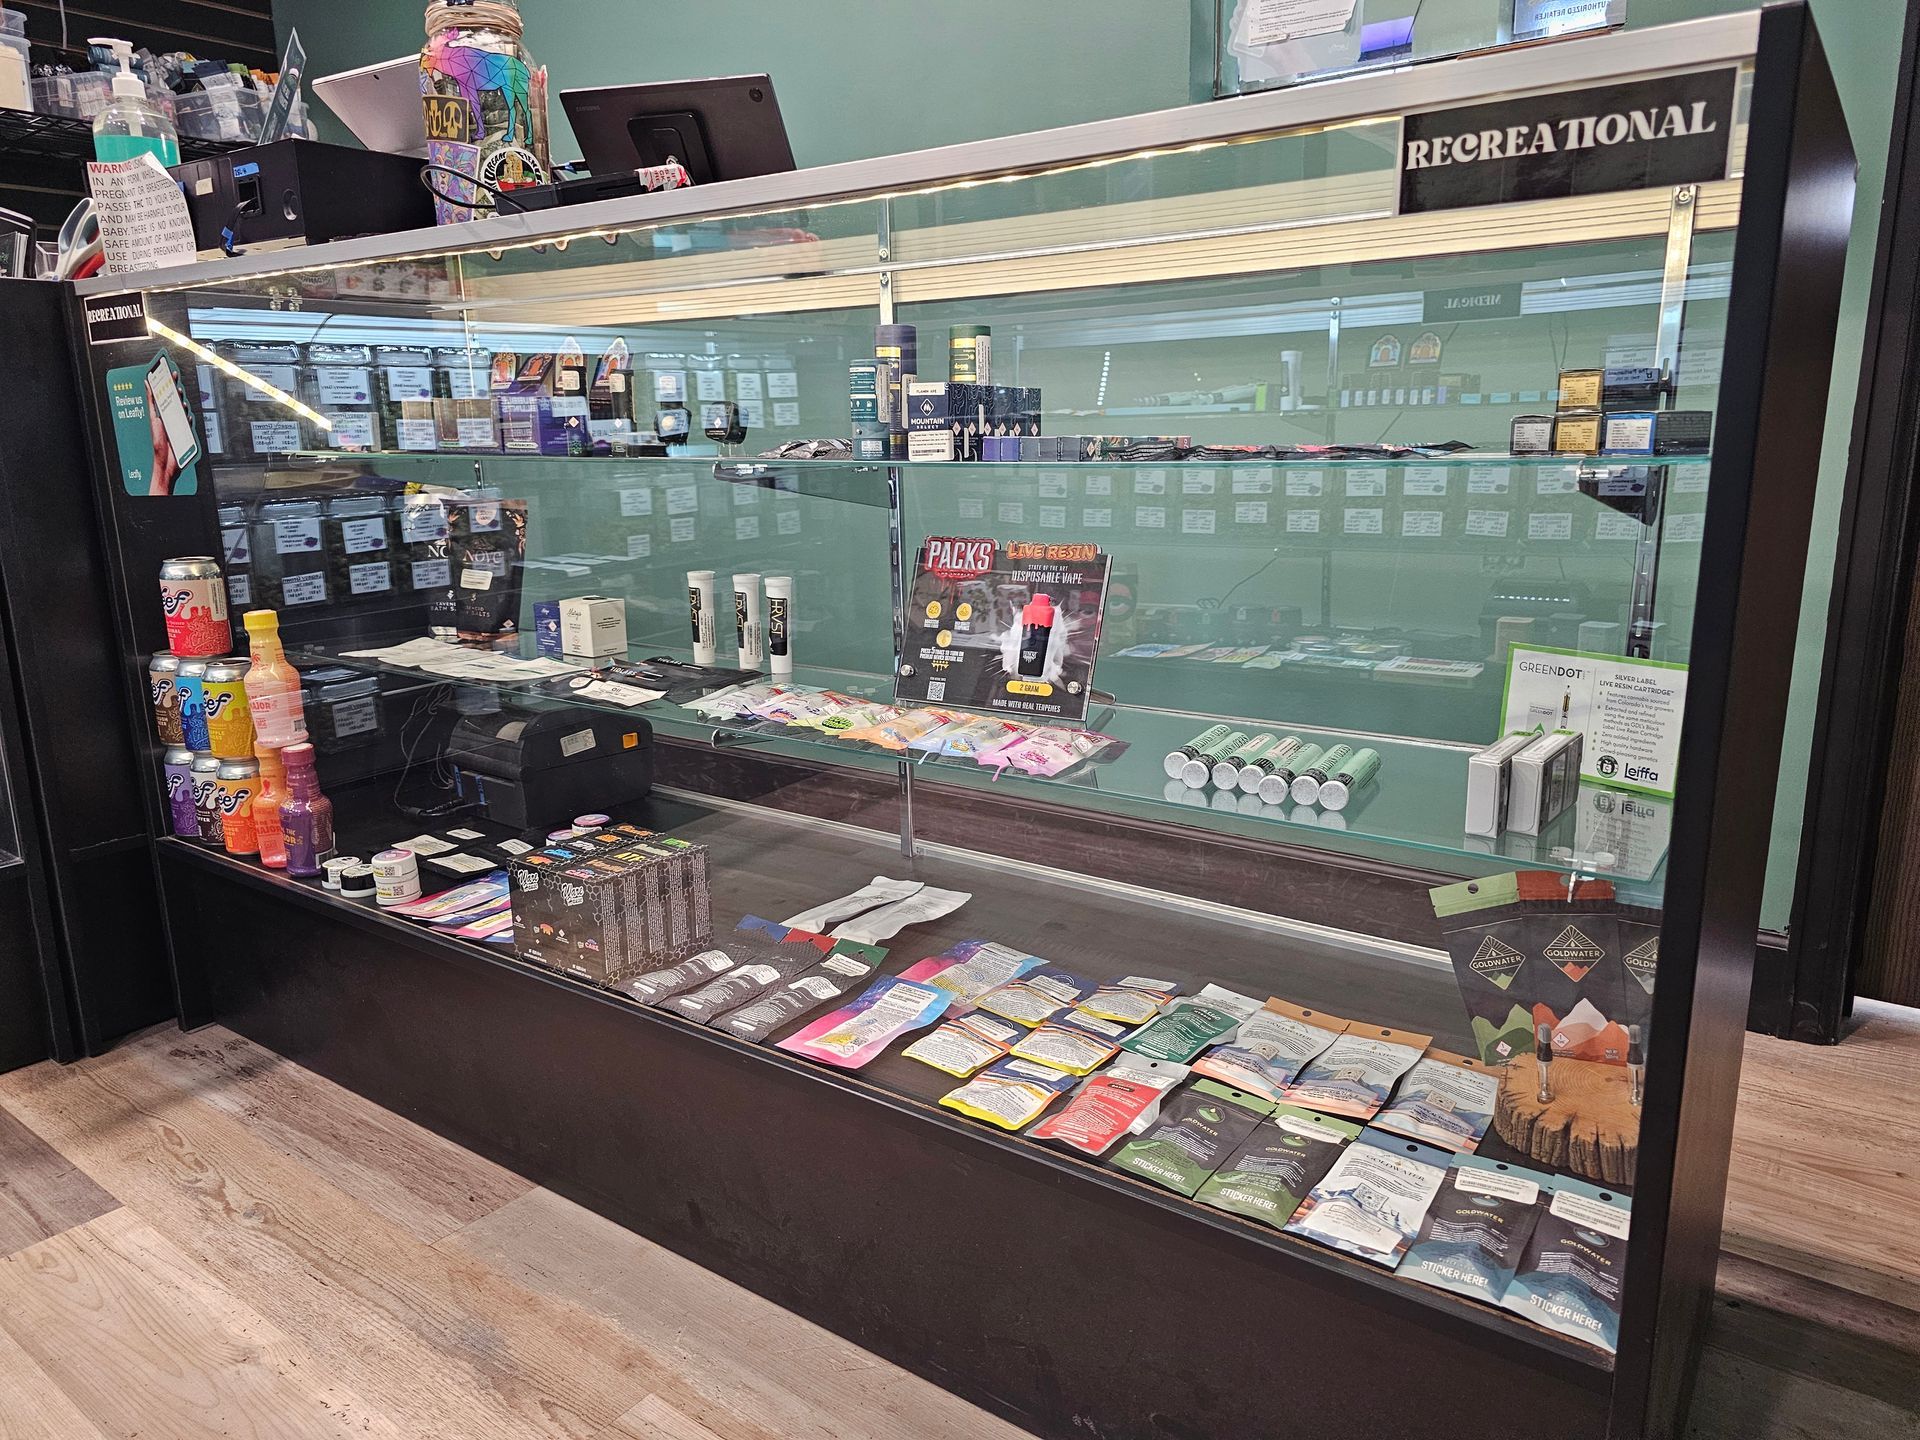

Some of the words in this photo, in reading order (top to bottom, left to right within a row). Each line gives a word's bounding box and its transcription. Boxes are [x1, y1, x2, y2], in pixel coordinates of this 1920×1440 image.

[1405, 101, 1717, 170] RECREATIONAL
[90, 161, 132, 174] WARNING
[92, 177, 104, 186] IN
[110, 177, 126, 186] ANY
[95, 188, 136, 199] PREGNANT
[98, 202, 132, 212] PASSES
[146, 196, 152, 206] TO
[155, 194, 168, 204] YOUR
[100, 215, 122, 224] AND
[144, 209, 166, 220] HARMFUL
[102, 228, 130, 236] BABY.
[158, 220, 166, 230] NO
[169, 216, 190, 228] KNOWN
[105, 240, 130, 248] SAFE
[132, 236, 152, 248] AMOUNT
[164, 229, 192, 242] MARIJUANA
[107, 252, 128, 260] USE
[154, 244, 184, 256] PREGNANCY
[186, 242, 195, 251] OR
[88, 304, 143, 323] RECREATIONAL
[116, 396, 133, 406] Review
[134, 396, 142, 404] us
[118, 411, 125, 420] on
[927, 540, 992, 570] PACKS
[1007, 541, 1044, 560] LIVE
[1046, 544, 1096, 560] RESIN
[1012, 570, 1060, 584] DISPOSABLE
[1062, 572, 1083, 584] VAPE
[771, 598, 784, 638] HRVST
[1519, 662, 1582, 678] GREENDOT
[1020, 684, 1024, 692] 2
[1024, 684, 1040, 692] GRAM
[1614, 682, 1632, 690] RESIN
[1615, 674, 1636, 682] SILVER
[1636, 677, 1656, 686] LABEL
[992, 699, 1007, 708] MADE
[1036, 702, 1061, 714] TERPENES
[1472, 955, 1522, 968] GOLDWATER
[1546, 949, 1600, 958] GOLDWATER
[1626, 956, 1657, 968] GOLDW
[1265, 1146, 1306, 1158] GOLDWATER
[1132, 1157, 1164, 1176] STICKER
[1162, 1170, 1186, 1184] HERE!
[1220, 1188, 1254, 1204] STICKER
[1252, 1197, 1277, 1212] HERE!
[1456, 1208, 1504, 1224] GOLDWATER
[1560, 1238, 1612, 1266] GOLDWATER
[1421, 1260, 1460, 1279] STICKER
[1460, 1273, 1489, 1288] HERE!
[1530, 1294, 1571, 1320] STICKER
[1570, 1312, 1602, 1332] HERE!
